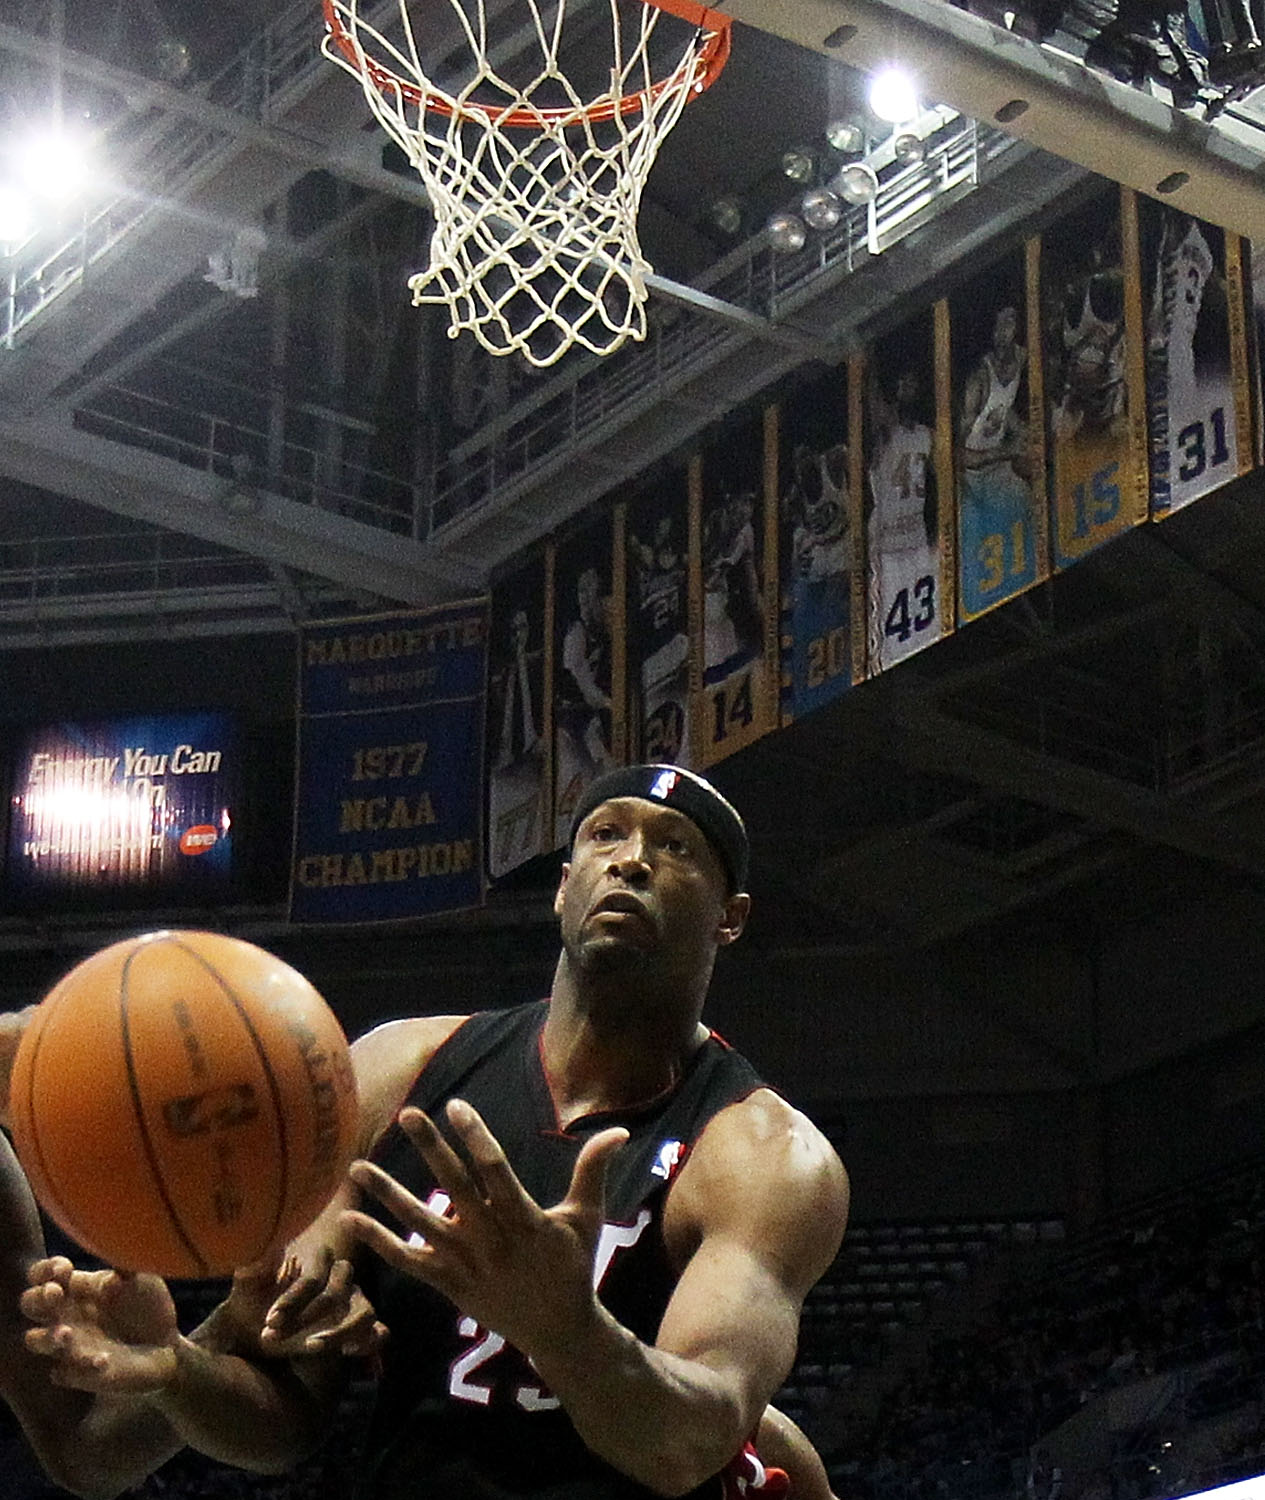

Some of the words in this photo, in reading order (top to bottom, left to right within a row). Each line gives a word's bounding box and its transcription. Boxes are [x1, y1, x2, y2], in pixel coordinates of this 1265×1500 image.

[1178, 407, 1230, 482] 31
[1071, 461, 1120, 539] 15
[979, 521, 1025, 593] 31
[885, 575, 935, 643] 43
[713, 675, 753, 743] 14
[124, 747, 168, 777] You
[171, 744, 222, 775] Can
[351, 742, 428, 781] 1977
[339, 792, 437, 832] NCAA
[449, 1316, 562, 1412] 2
